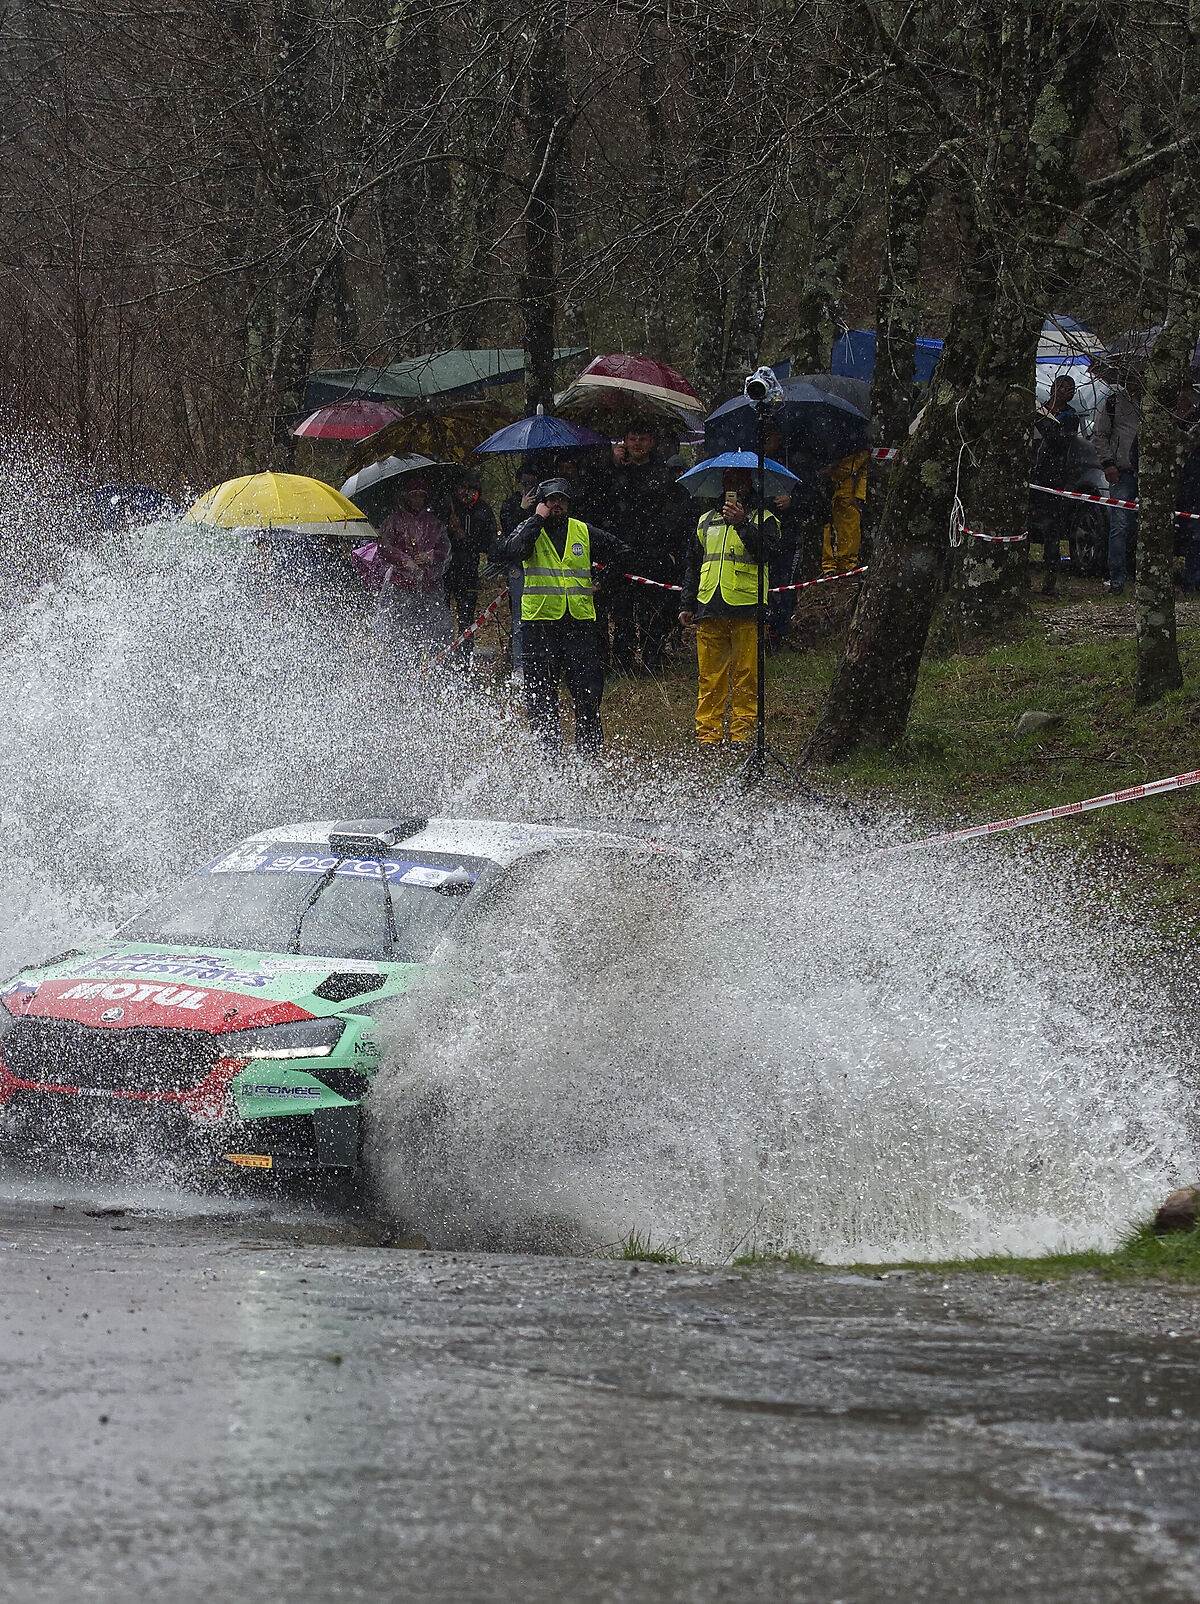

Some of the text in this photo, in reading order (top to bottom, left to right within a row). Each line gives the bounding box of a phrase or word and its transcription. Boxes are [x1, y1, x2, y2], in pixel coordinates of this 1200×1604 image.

[271, 853, 401, 876] sparco
[58, 982, 209, 1010] MOTUL
[255, 1085, 321, 1095] FOMEC
